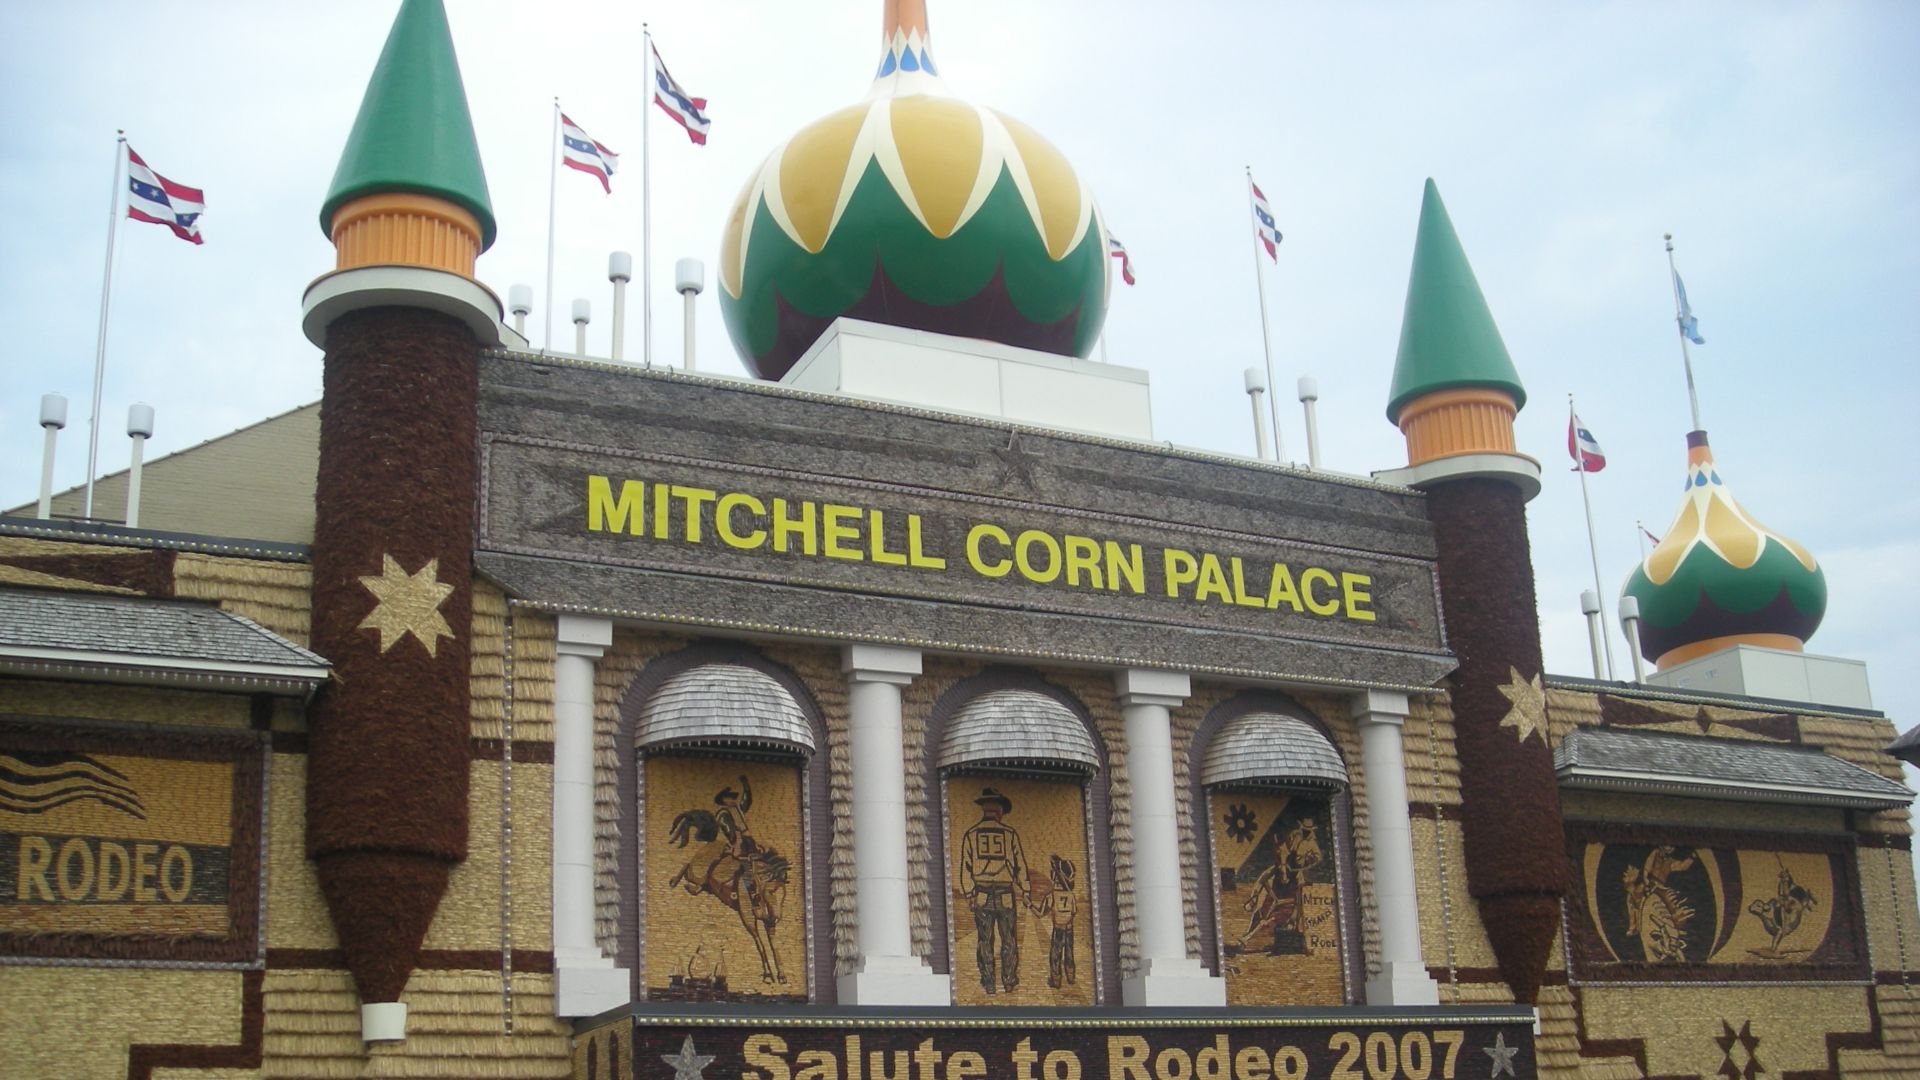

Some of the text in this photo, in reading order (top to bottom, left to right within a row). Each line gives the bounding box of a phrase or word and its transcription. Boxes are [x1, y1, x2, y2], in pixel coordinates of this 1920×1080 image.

[588, 474, 1376, 621] MITCHELL CORN PALACE
[17, 836, 193, 901] RODEO
[979, 834, 1003, 854] 35
[1060, 895, 1068, 909] 7
[741, 1031, 1465, 1080] Salute to Rodeo 2007
